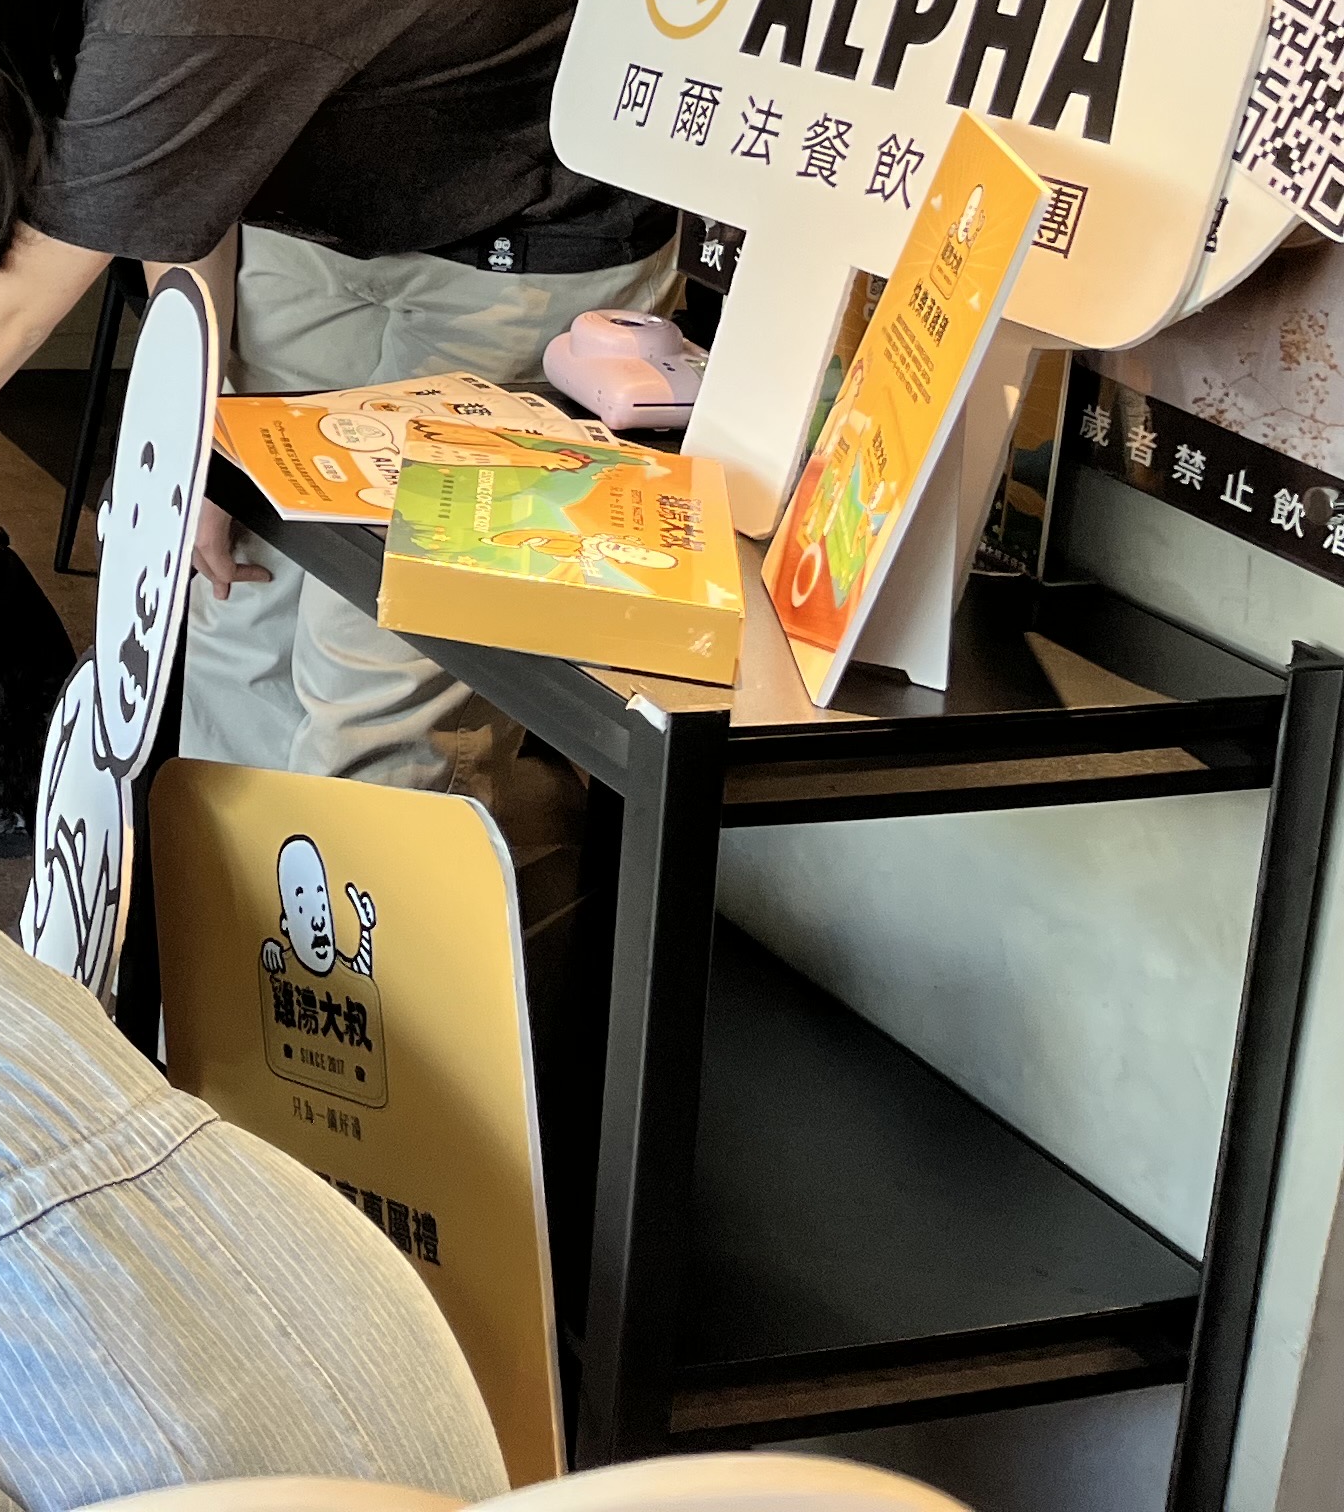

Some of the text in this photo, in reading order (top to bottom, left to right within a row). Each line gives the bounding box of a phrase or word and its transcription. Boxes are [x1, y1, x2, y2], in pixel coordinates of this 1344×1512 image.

[612, 62, 1089, 259] 阿爾法餐飲團
[269, 975, 373, 1052] 雞湯大叔
[300, 1046, 345, 1075] SINCE 2017
